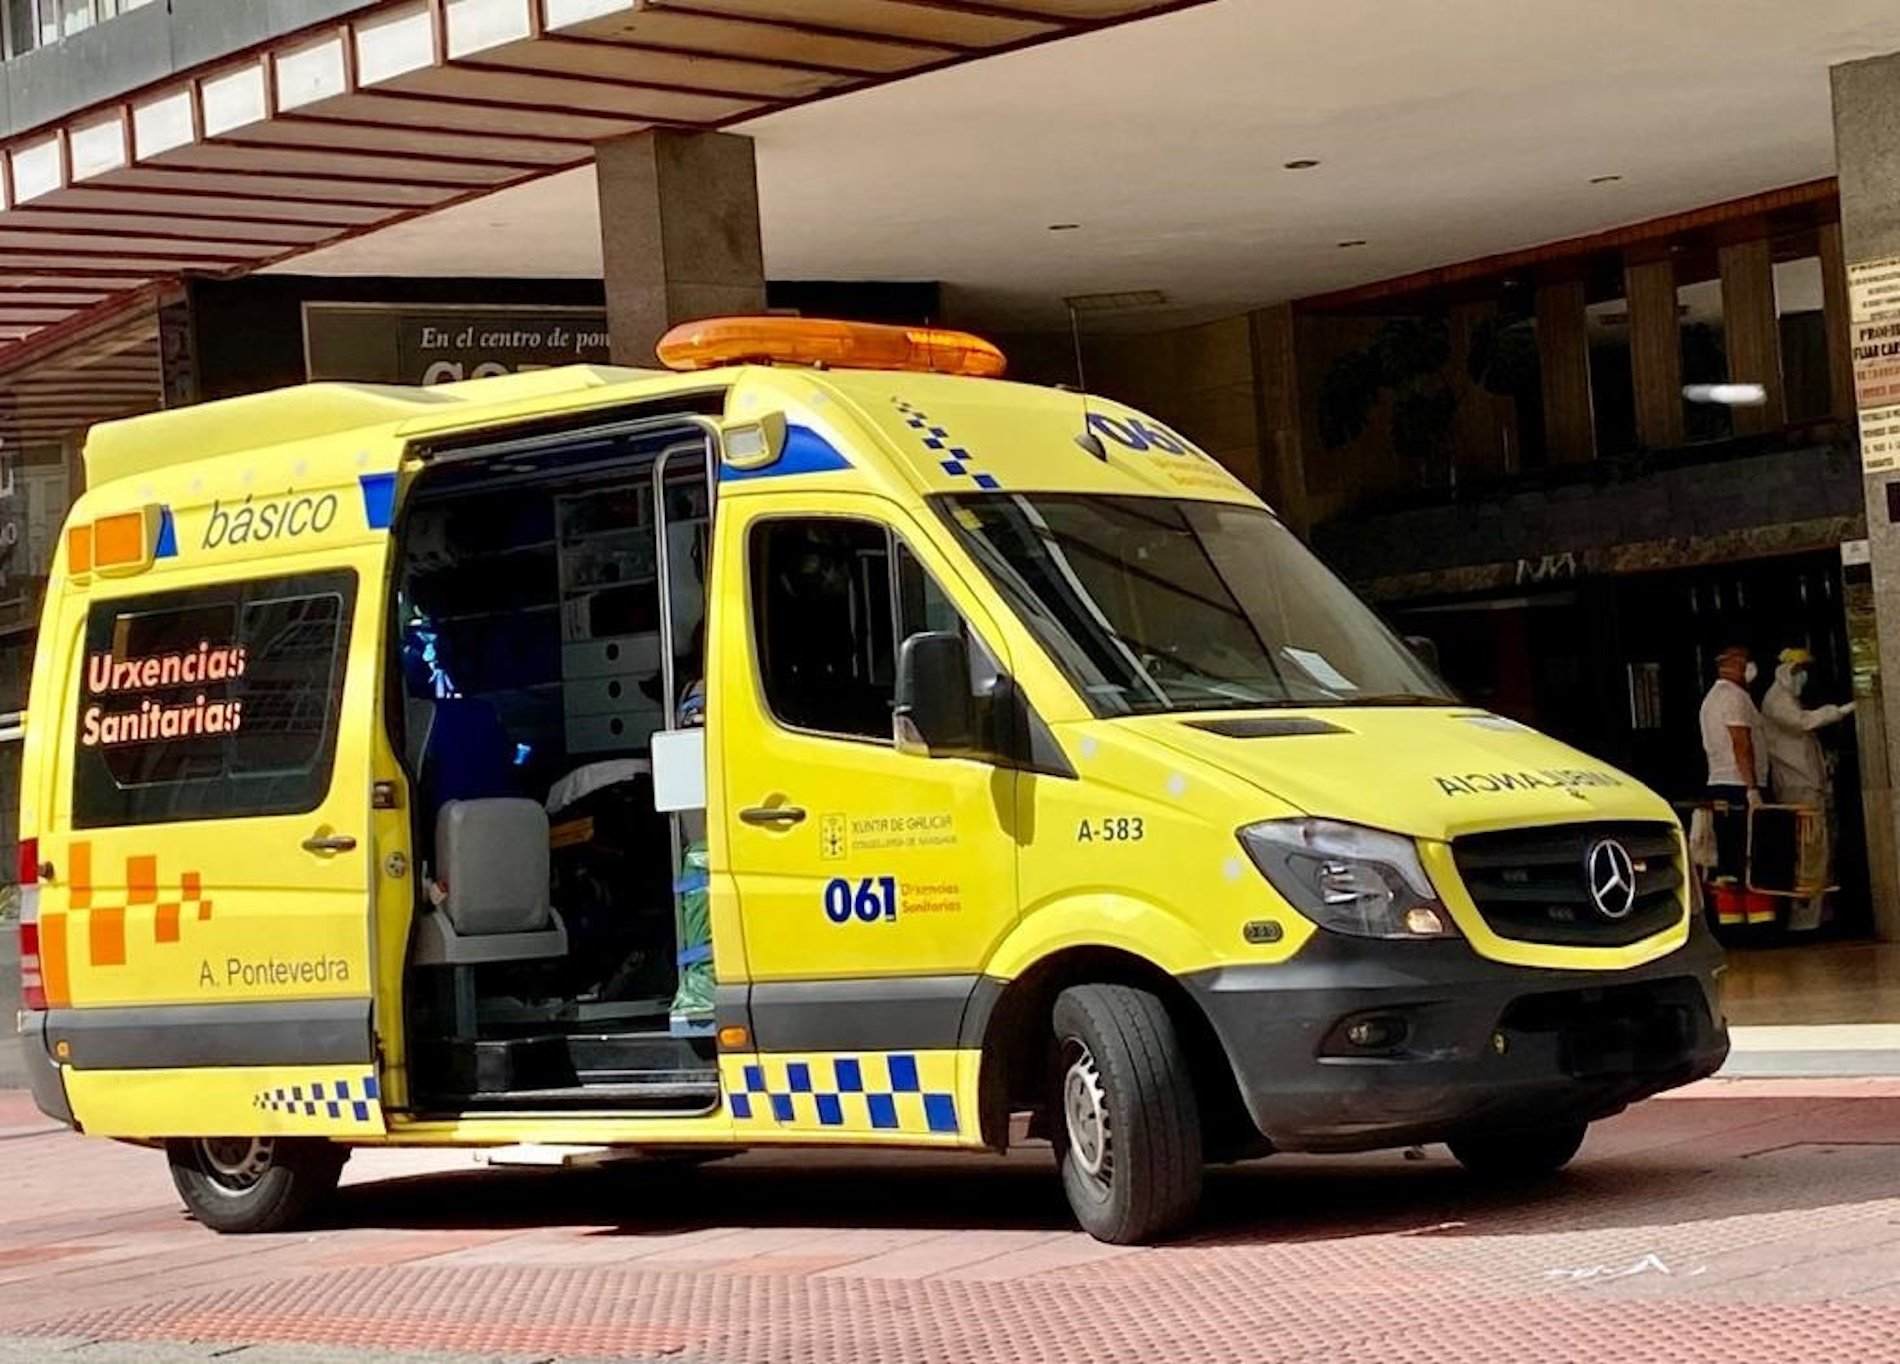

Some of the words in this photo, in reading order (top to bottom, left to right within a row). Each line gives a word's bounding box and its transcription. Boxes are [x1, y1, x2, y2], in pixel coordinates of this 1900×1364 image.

[420, 327, 448, 348] En
[456, 326, 473, 348] el
[480, 329, 541, 348] centro
[547, 327, 569, 348] de
[202, 487, 338, 550] básico
[88, 640, 246, 693] Urxencias
[82, 695, 241, 746] Sanitarias
[852, 818, 888, 833] XUNTA
[890, 817, 904, 832] DE
[906, 814, 952, 831] GALICIA
[1077, 817, 1145, 842] A-583
[824, 876, 897, 923] 061
[200, 960, 220, 987] A.
[228, 955, 349, 985] Pontevedra
